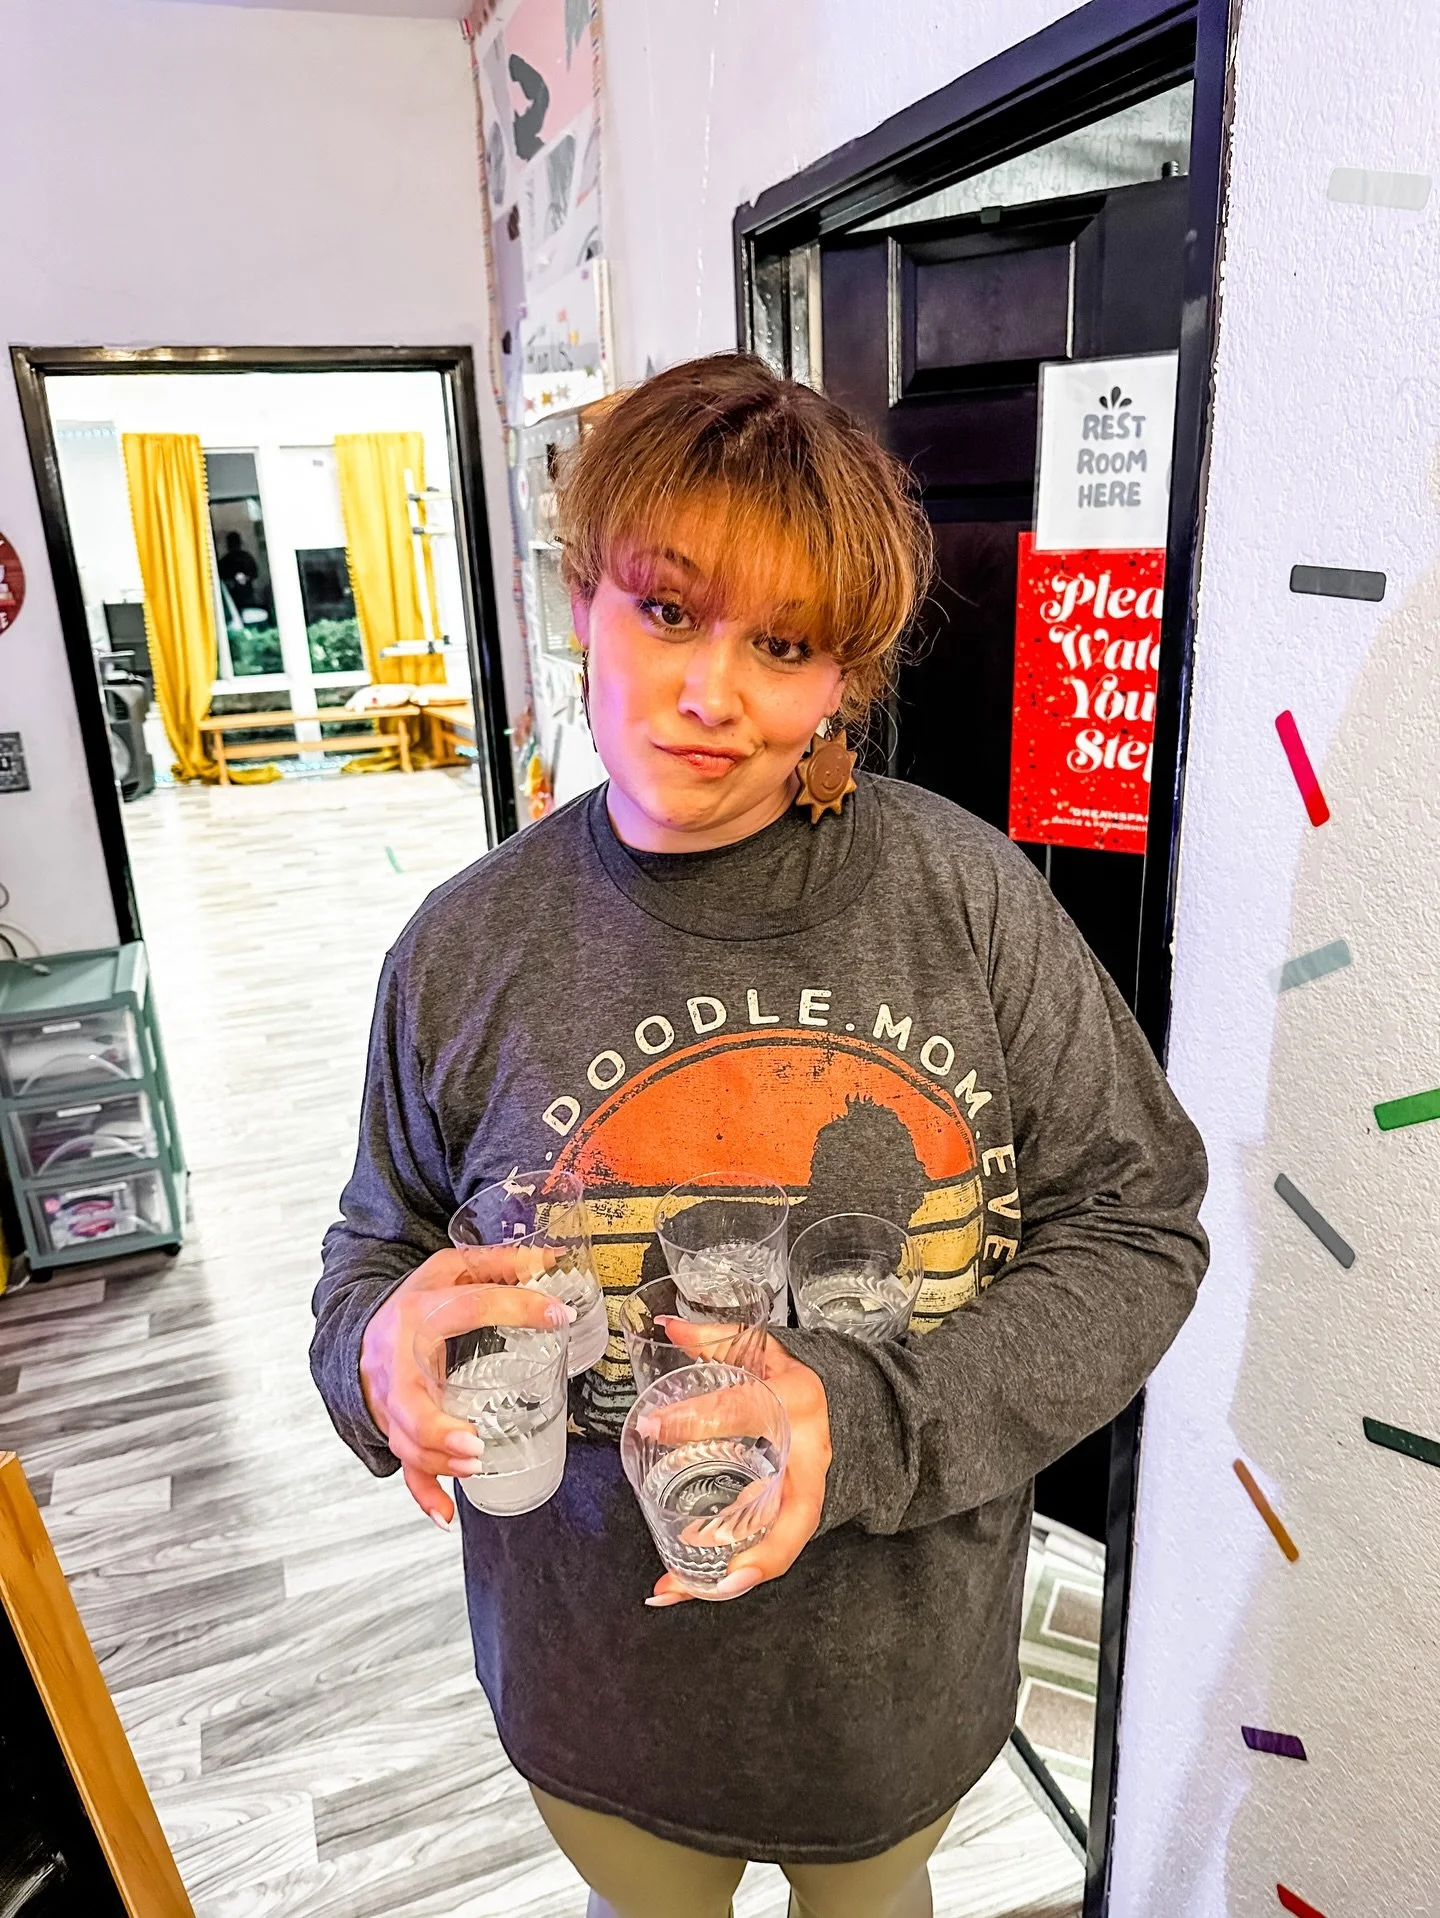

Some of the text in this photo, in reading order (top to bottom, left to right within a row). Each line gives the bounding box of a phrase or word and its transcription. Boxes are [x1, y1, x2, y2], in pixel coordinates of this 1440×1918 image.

[1082, 412, 1146, 441] REST
[1077, 448, 1147, 475] ROOM
[1078, 481, 1141, 508] HERE
[1040, 572, 1163, 624] Plea
[1069, 673, 1156, 722] You
